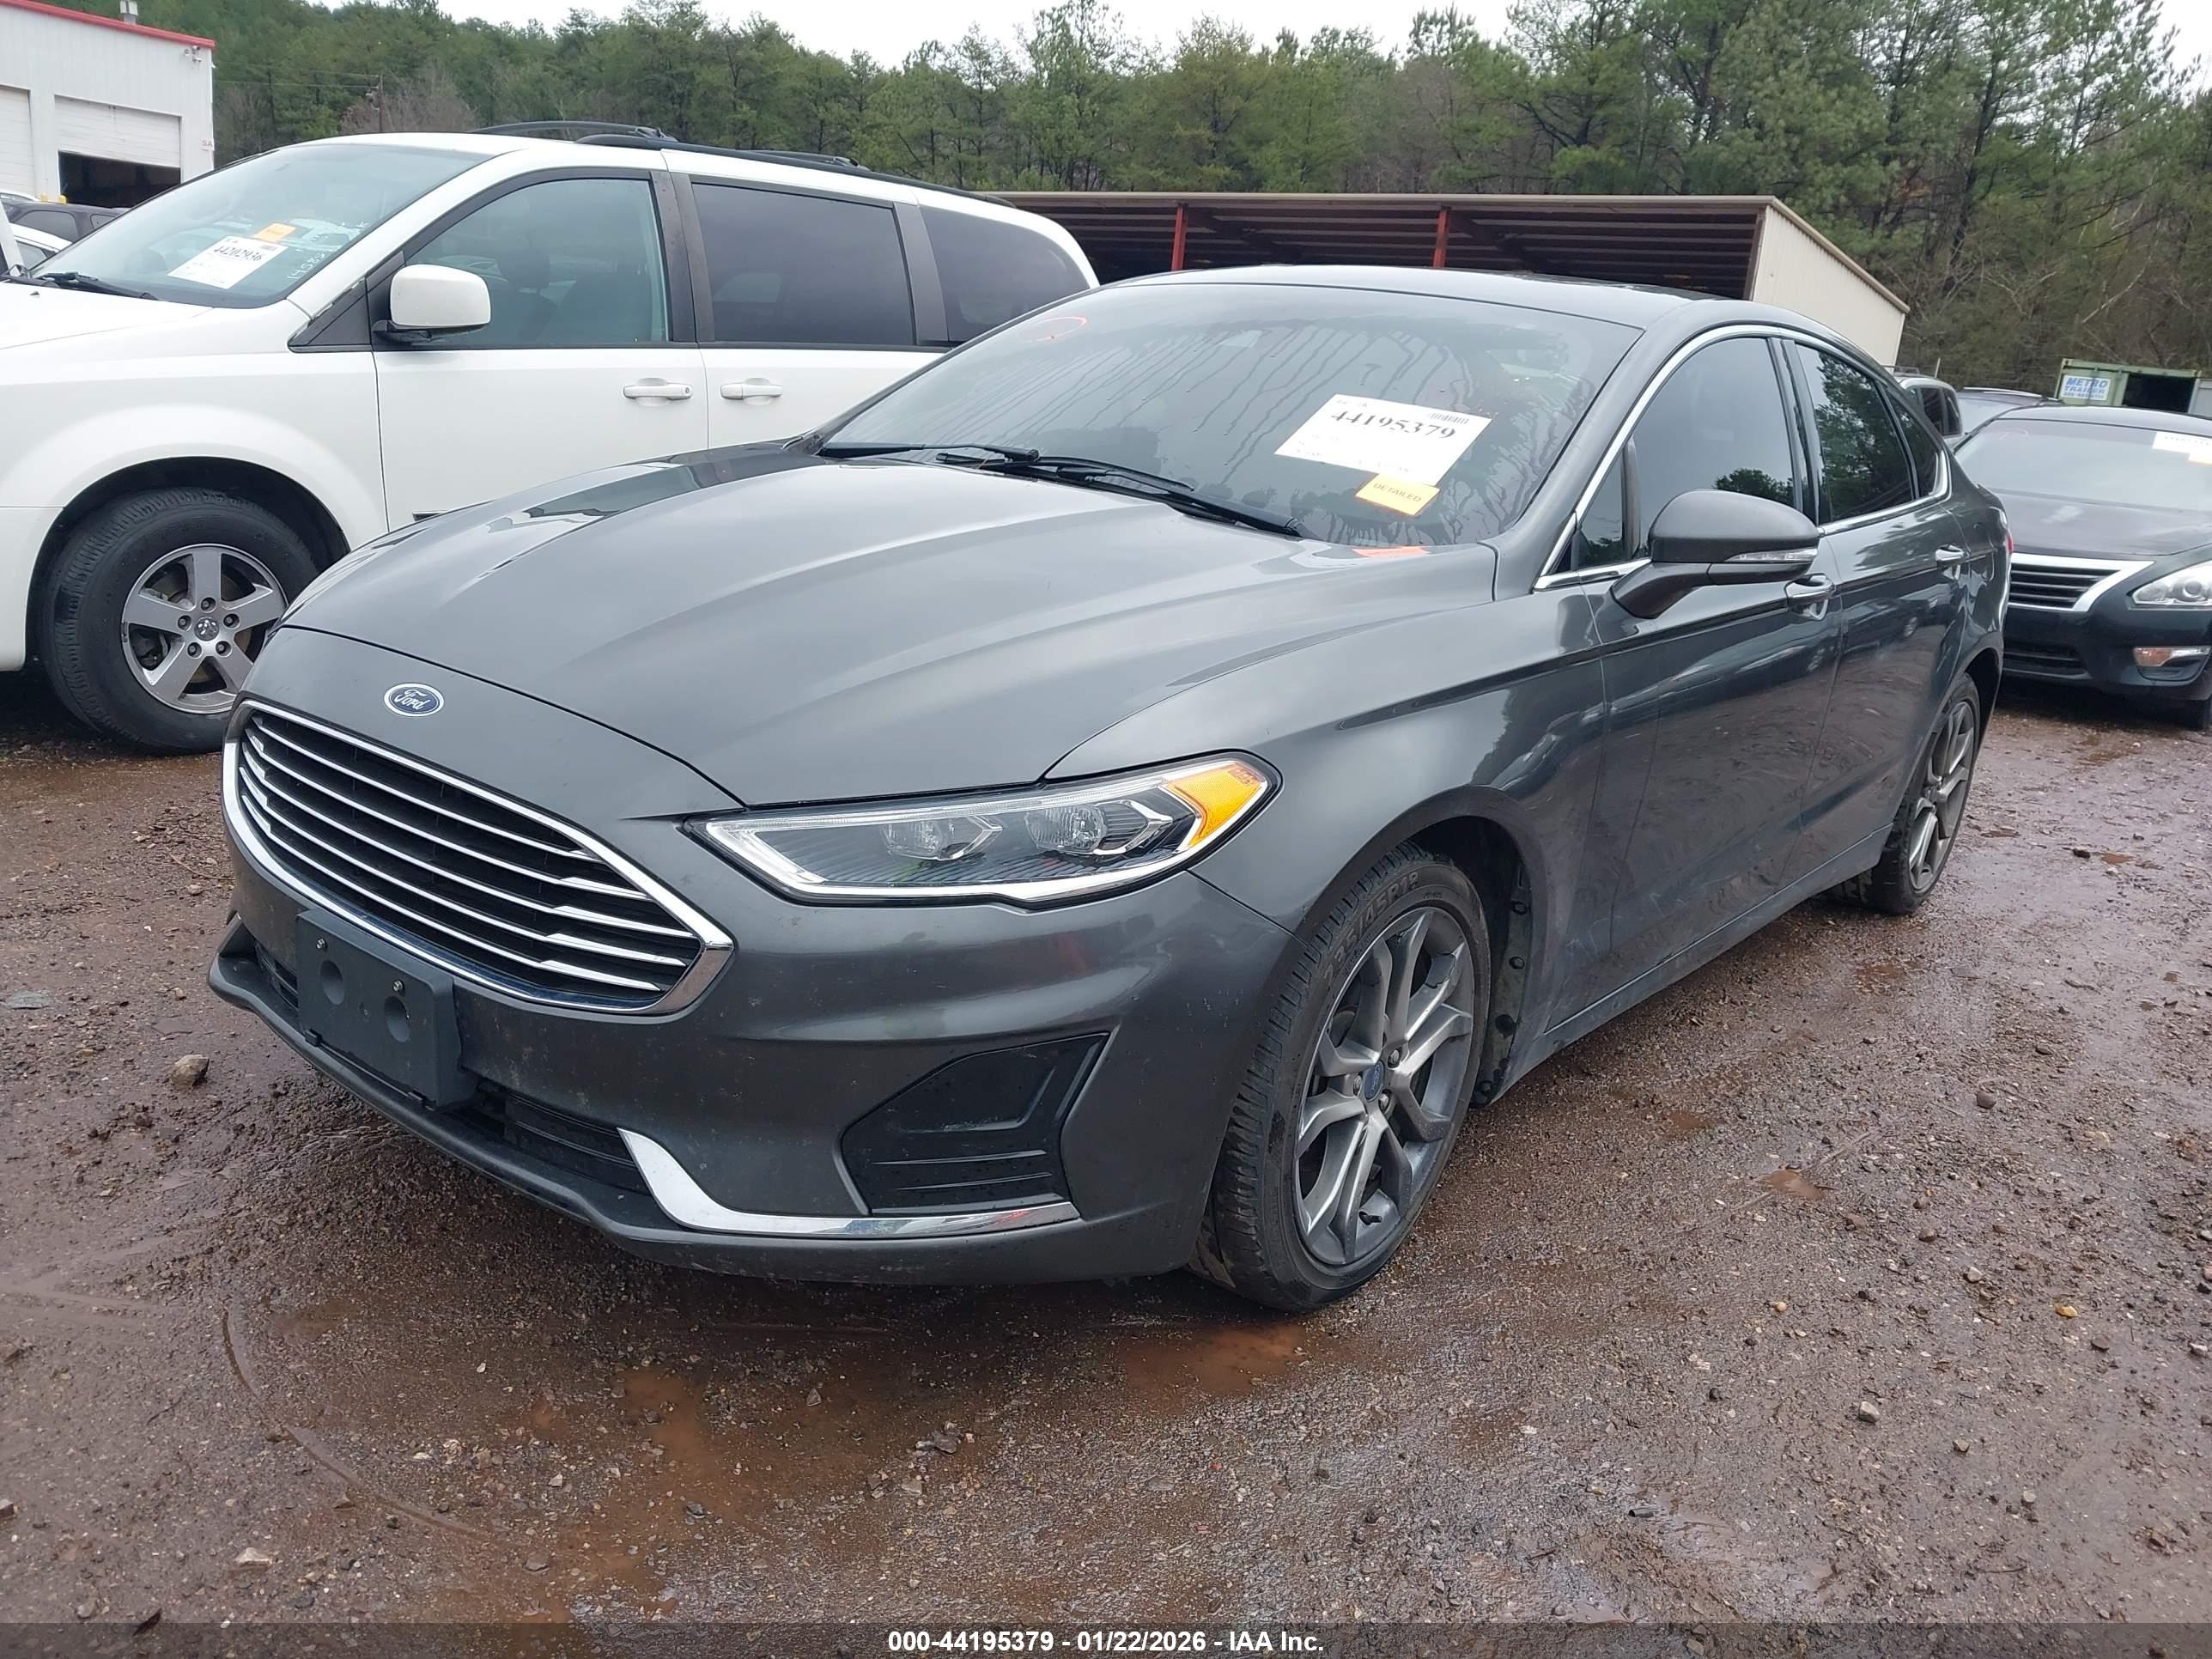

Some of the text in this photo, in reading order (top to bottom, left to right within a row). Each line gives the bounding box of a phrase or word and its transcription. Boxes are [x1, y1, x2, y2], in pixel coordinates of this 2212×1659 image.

[2064, 386, 2106, 398] TRAILER
[2067, 377, 2108, 388] METRO
[1331, 410, 1455, 438] 44195379
[1372, 483, 1422, 502] DETAILED
[394, 689, 431, 710] Ford
